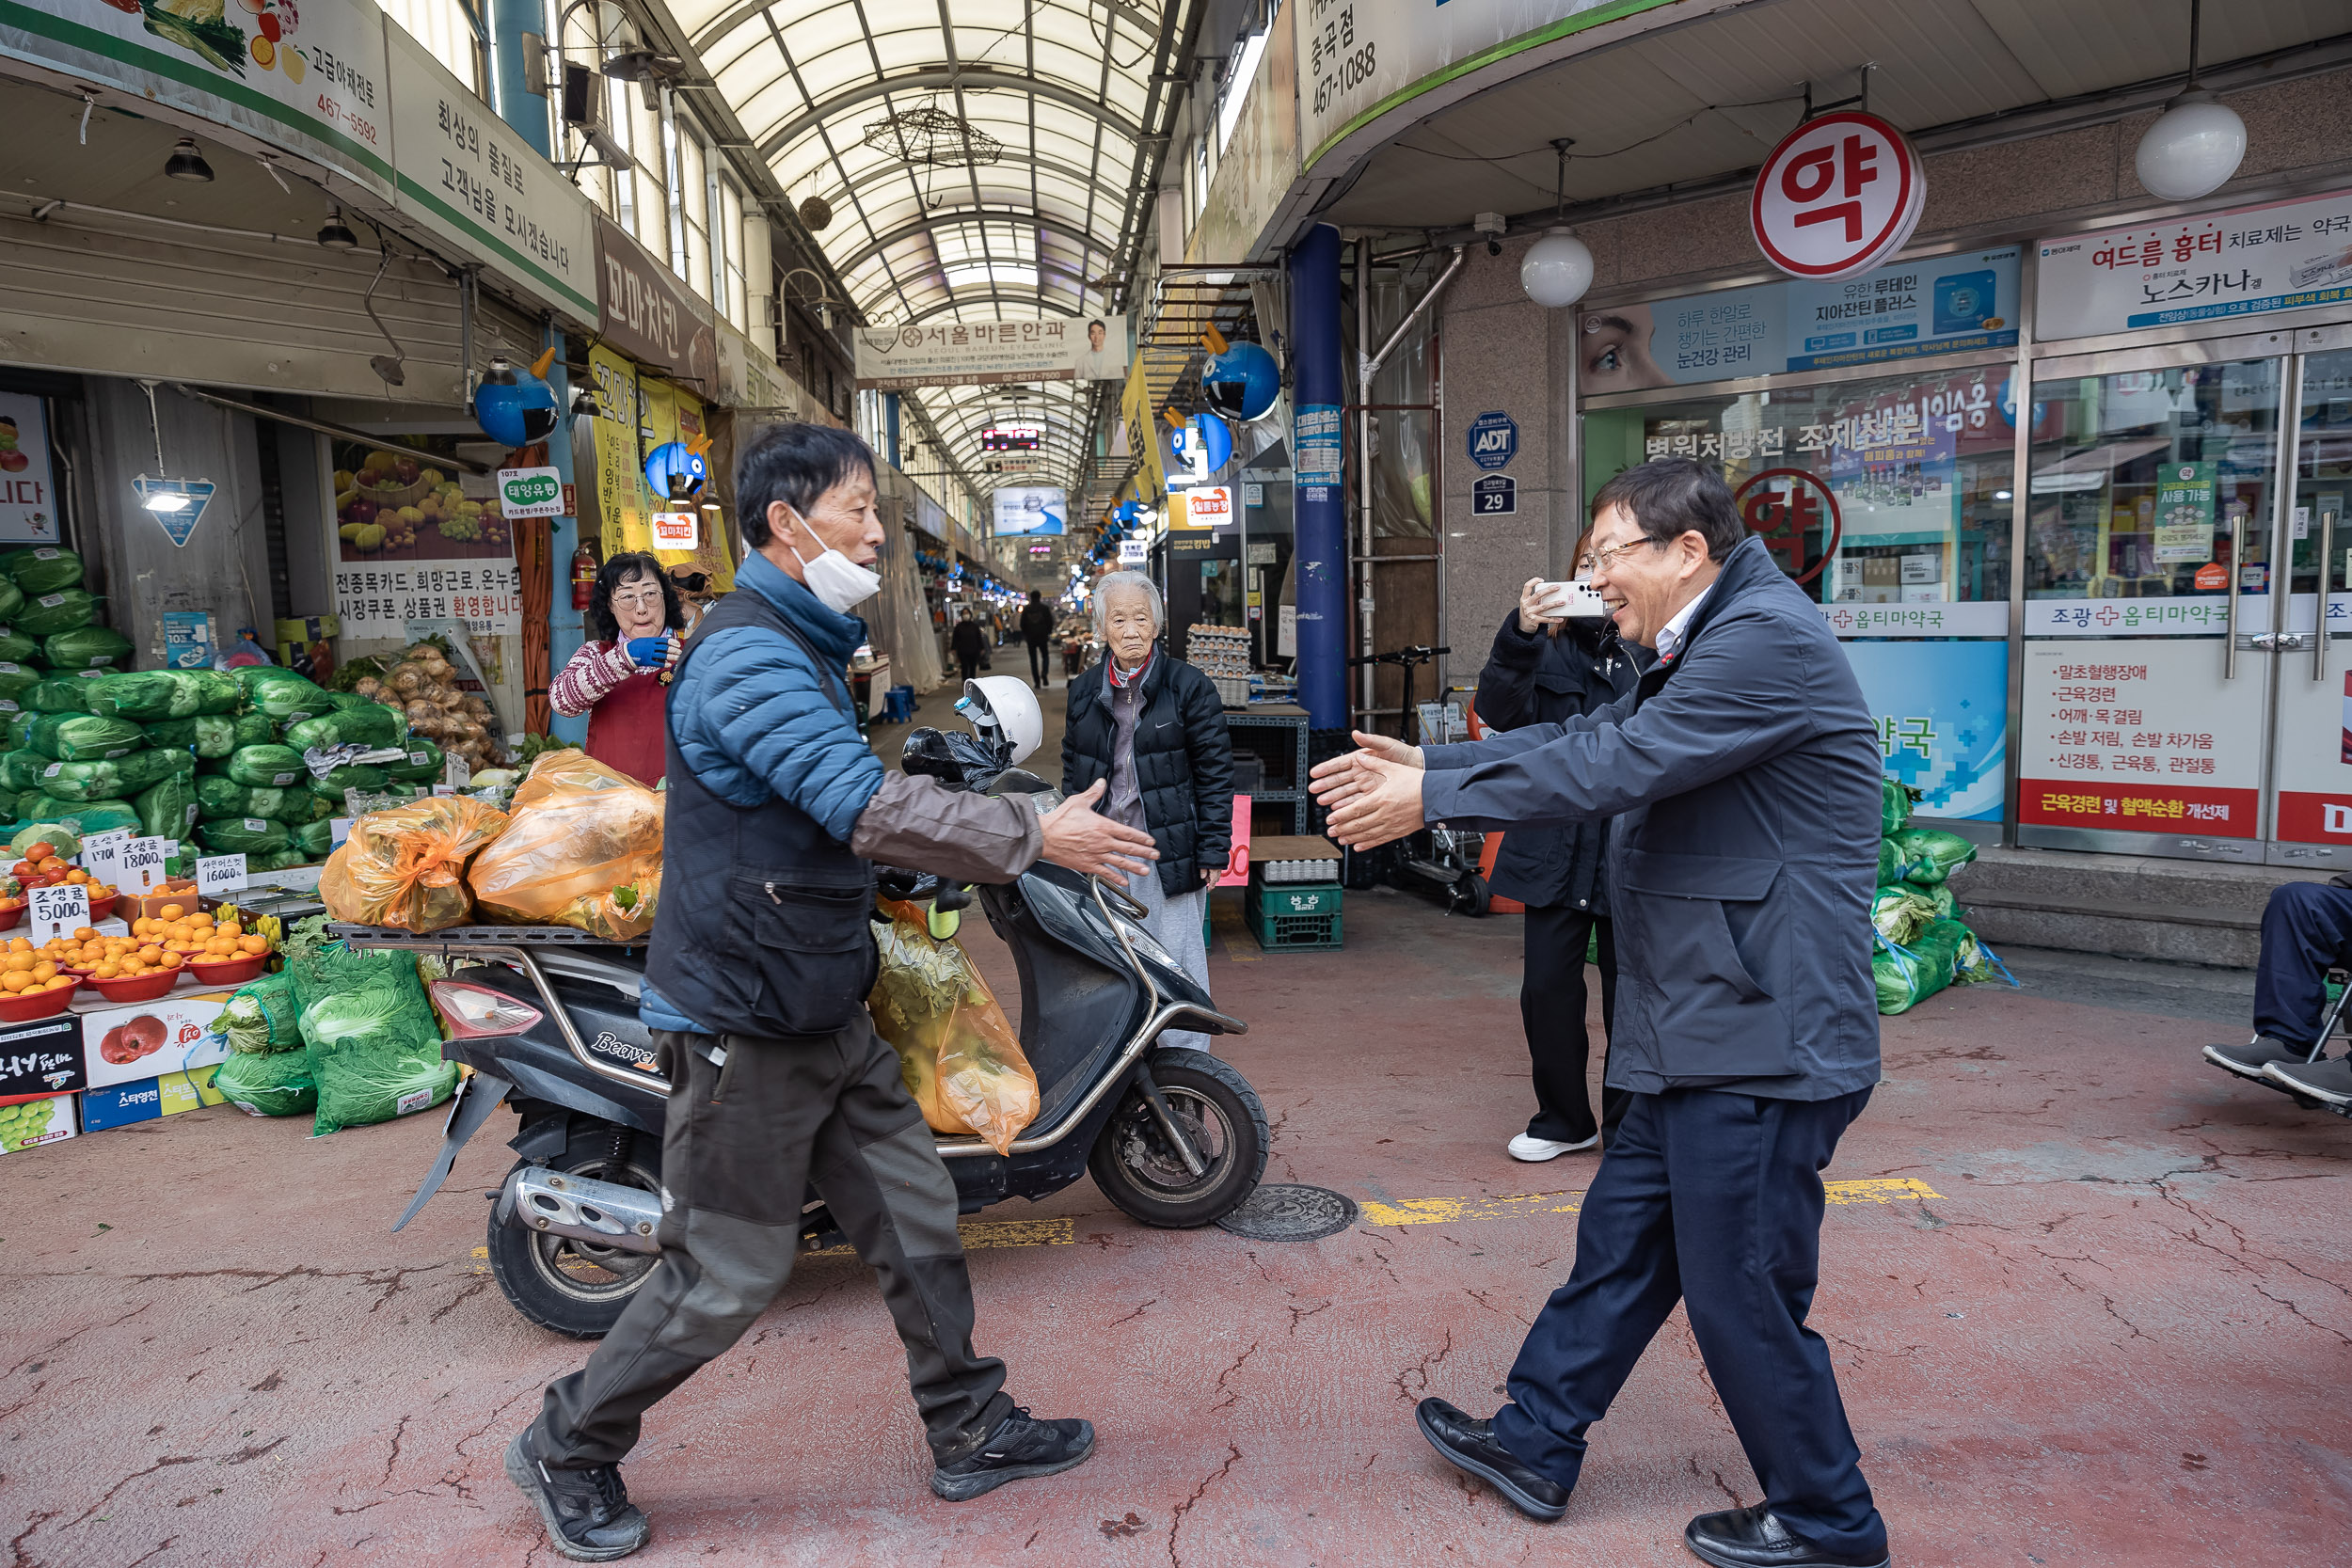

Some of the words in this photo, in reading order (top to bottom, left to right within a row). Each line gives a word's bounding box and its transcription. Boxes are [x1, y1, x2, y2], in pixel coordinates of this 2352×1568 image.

[1311, 4, 1354, 77] 중곡점
[312, 43, 375, 110] 고급야채전문
[1312, 41, 1376, 118] 467-1088
[316, 92, 377, 146] 467-5592
[437, 98, 482, 163] 최상의
[487, 142, 526, 197] 품질로
[1782, 135, 1877, 243] 약
[440, 155, 497, 226] 고객님을
[504, 209, 571, 276] 모시겠습니다
[2092, 239, 2164, 270] 여드름
[2171, 230, 2222, 264] 흉터
[2229, 225, 2302, 249] 치료제는
[1844, 283, 1871, 300] 유한
[1874, 275, 1917, 296] 루테인
[605, 252, 679, 360] 꼬마치킨
[1816, 301, 1871, 322] 지아잔틴
[1873, 294, 1917, 315] 플러스
[2251, 297, 2281, 311] 검증된
[2284, 293, 2315, 306] 피부색
[2319, 290, 2340, 301] 회복
[1677, 309, 1704, 329] 하루
[1709, 303, 1752, 325] 한알로
[927, 322, 1066, 346] 서울바른안과
[1677, 329, 1720, 350] 챙기는
[1724, 322, 1767, 343] 간편한
[965, 345, 1005, 354] BAREUN
[1677, 349, 1719, 371] 눈건강
[1724, 343, 1751, 365] 관리
[1475, 429, 1510, 451] ADT
[1645, 425, 1785, 463] 병원처방전
[1796, 414, 1924, 452] 조제전문
[507, 483, 556, 499] 태양유통
[1485, 494, 1503, 510] 29
[2161, 490, 2185, 503] 사용
[2187, 488, 2211, 501] 가능
[1195, 500, 1229, 512] 일품농장
[660, 525, 691, 538] 꼬마치킨
[1744, 486, 1817, 568] 약
[1854, 610, 1945, 629] 옵티마약국
[2051, 606, 2091, 627] 조광
[2058, 664, 2148, 680] 말초혈행장애
[2058, 687, 2116, 703] 근육경련
[2113, 710, 2143, 725] 결림
[2058, 730, 2086, 747] 손발
[2090, 732, 2124, 749] 저림,
[2131, 733, 2163, 749] 손발
[2167, 733, 2215, 750] 차가움
[2057, 753, 2105, 771] 신경통,
[2111, 755, 2162, 773] 근육통,
[2168, 757, 2216, 774] 관절통
[2042, 793, 2101, 814] 근육경련
[2104, 799, 2117, 815] 및
[2121, 798, 2185, 819] 혈액순환
[2186, 803, 2230, 821] 개선제
[119, 1091, 158, 1108] 스타영천
